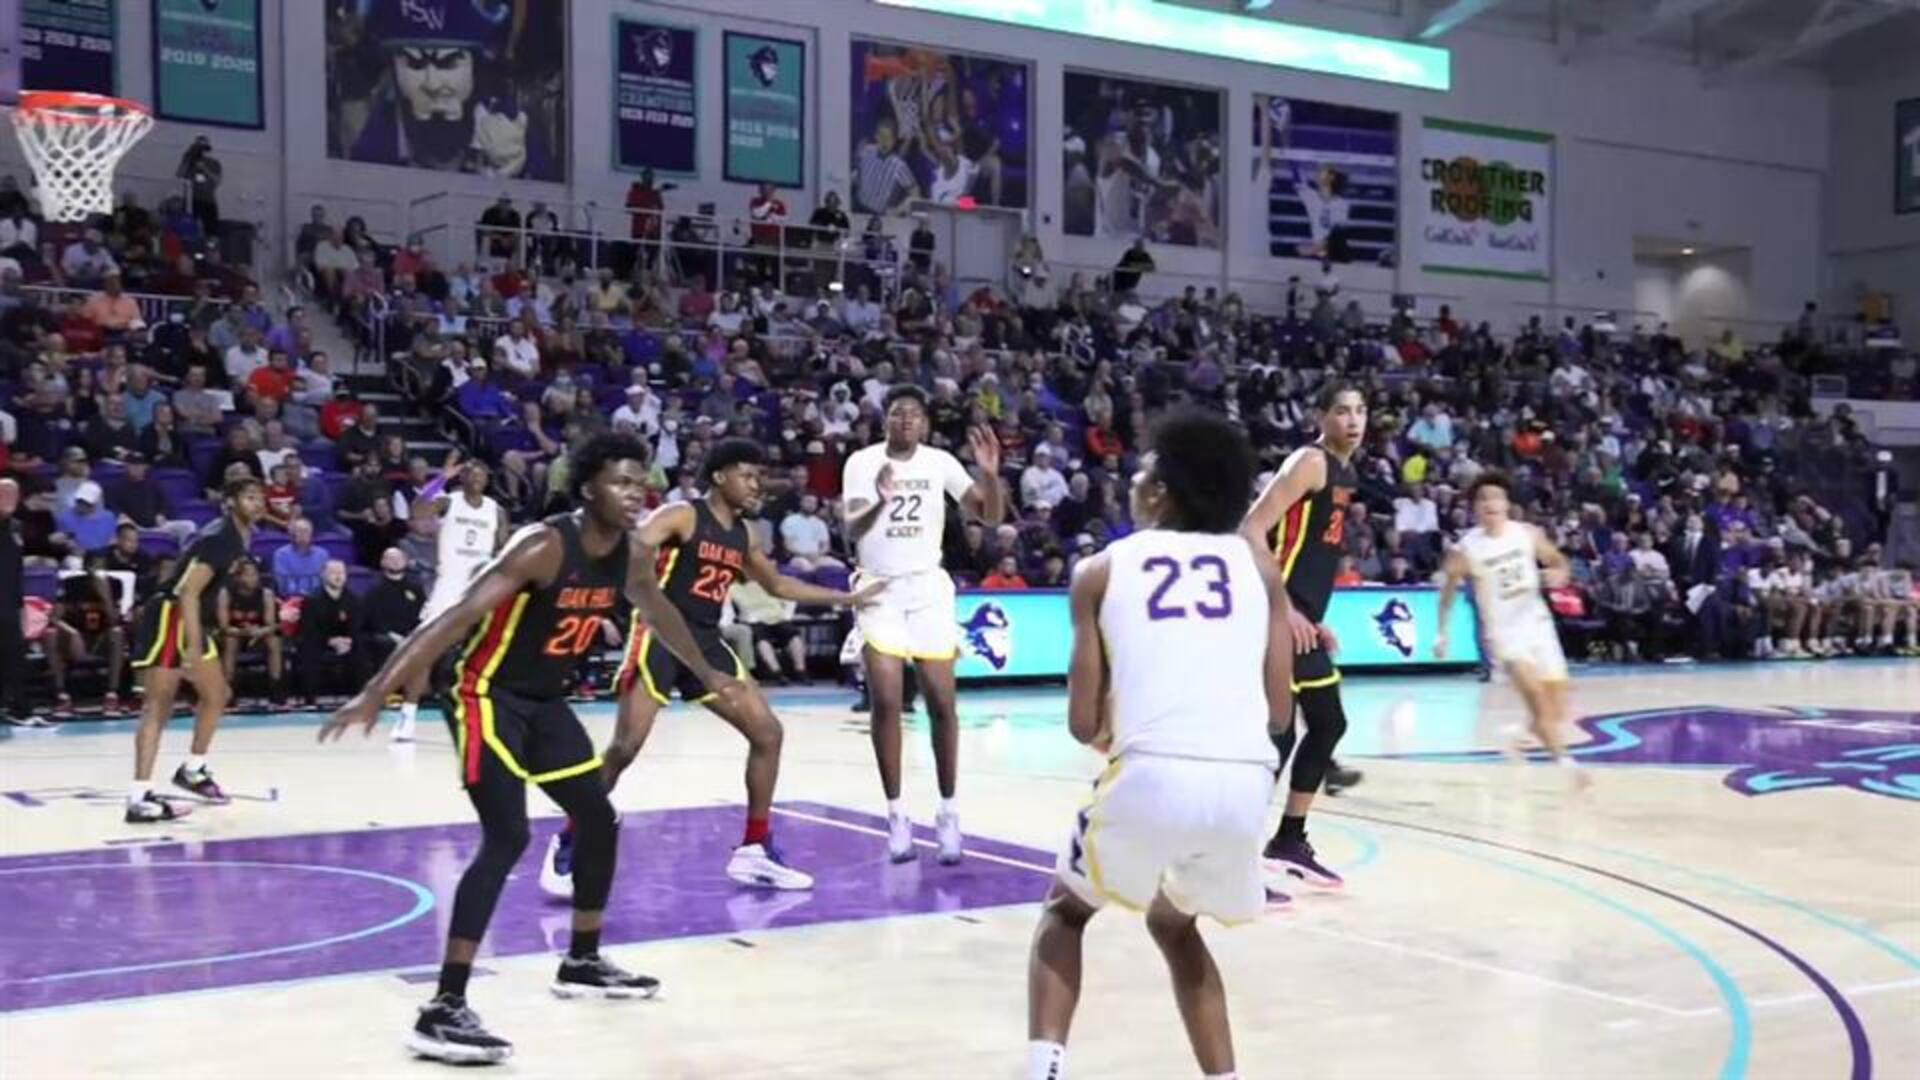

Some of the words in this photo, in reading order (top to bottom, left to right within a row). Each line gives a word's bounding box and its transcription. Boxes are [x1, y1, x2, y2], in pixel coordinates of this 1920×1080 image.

[161, 47, 206, 66] 2019
[211, 52, 256, 73] 2020
[1421, 156, 1545, 196] CROWTHER
[1431, 188, 1534, 223] ROOFING
[889, 494, 922, 521] 22
[692, 564, 734, 602] 23
[1142, 555, 1232, 620] 23
[546, 615, 601, 655] 20
